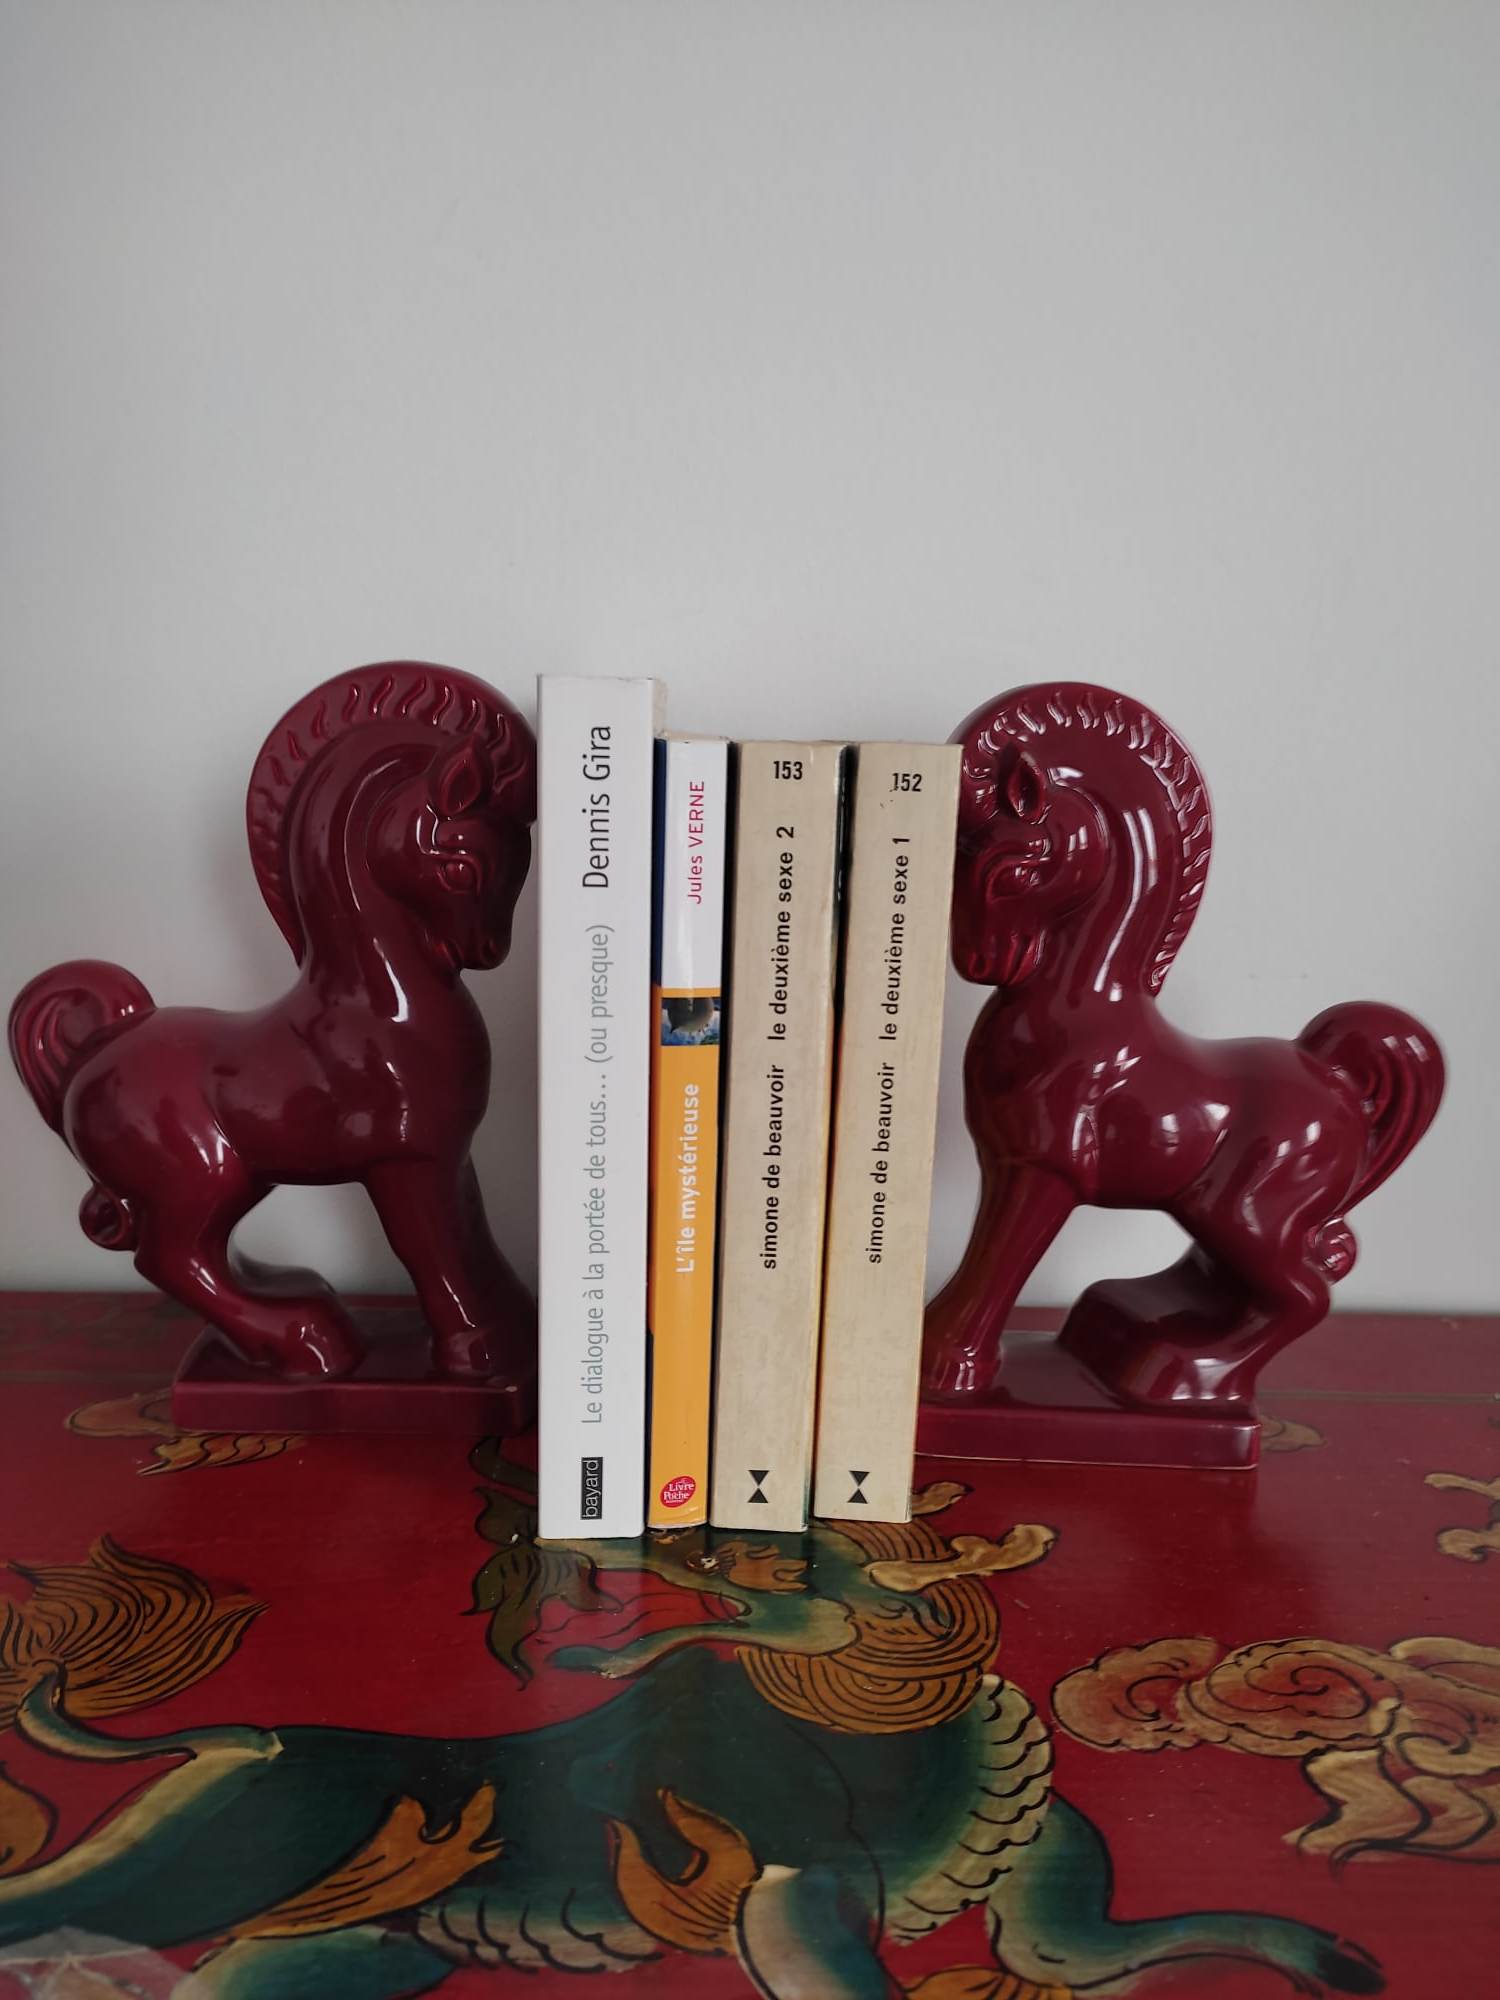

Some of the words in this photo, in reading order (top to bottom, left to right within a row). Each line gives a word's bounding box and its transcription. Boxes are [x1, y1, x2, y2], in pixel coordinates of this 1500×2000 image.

[581, 725, 612, 782] Gira
[773, 760, 803, 781] 153
[892, 772, 922, 793] 152
[687, 780, 705, 849] VERNE
[775, 825, 795, 840] 2
[581, 793, 611, 889] Dennis
[891, 837, 911, 845] 1
[687, 855, 704, 905] Jules
[779, 851, 794, 904] sexe
[892, 854, 910, 905] sexe
[585, 924, 615, 1018] presque)
[767, 910, 791, 1016] deuxième
[879, 912, 906, 1016] deuxième
[583, 1027, 614, 1064] (ou
[766, 1022, 787, 1041] le
[877, 1022, 898, 1041] le
[762, 1064, 785, 1157] beauvoir
[870, 1061, 896, 1153] beauvoir
[582, 1154, 606, 1180] de
[678, 1083, 700, 1220] mystérieuse
[761, 1163, 781, 1189] de
[868, 1159, 889, 1185] de
[583, 1187, 611, 1255] portée
[759, 1195, 780, 1270] simone
[864, 1191, 888, 1265] simone
[581, 1263, 605, 1280] la
[582, 1288, 604, 1300] à
[580, 1307, 609, 1395] dialogue
[580, 1401, 603, 1424] Le
[582, 1459, 601, 1517] bayard
[669, 1481, 695, 1492] Livre
